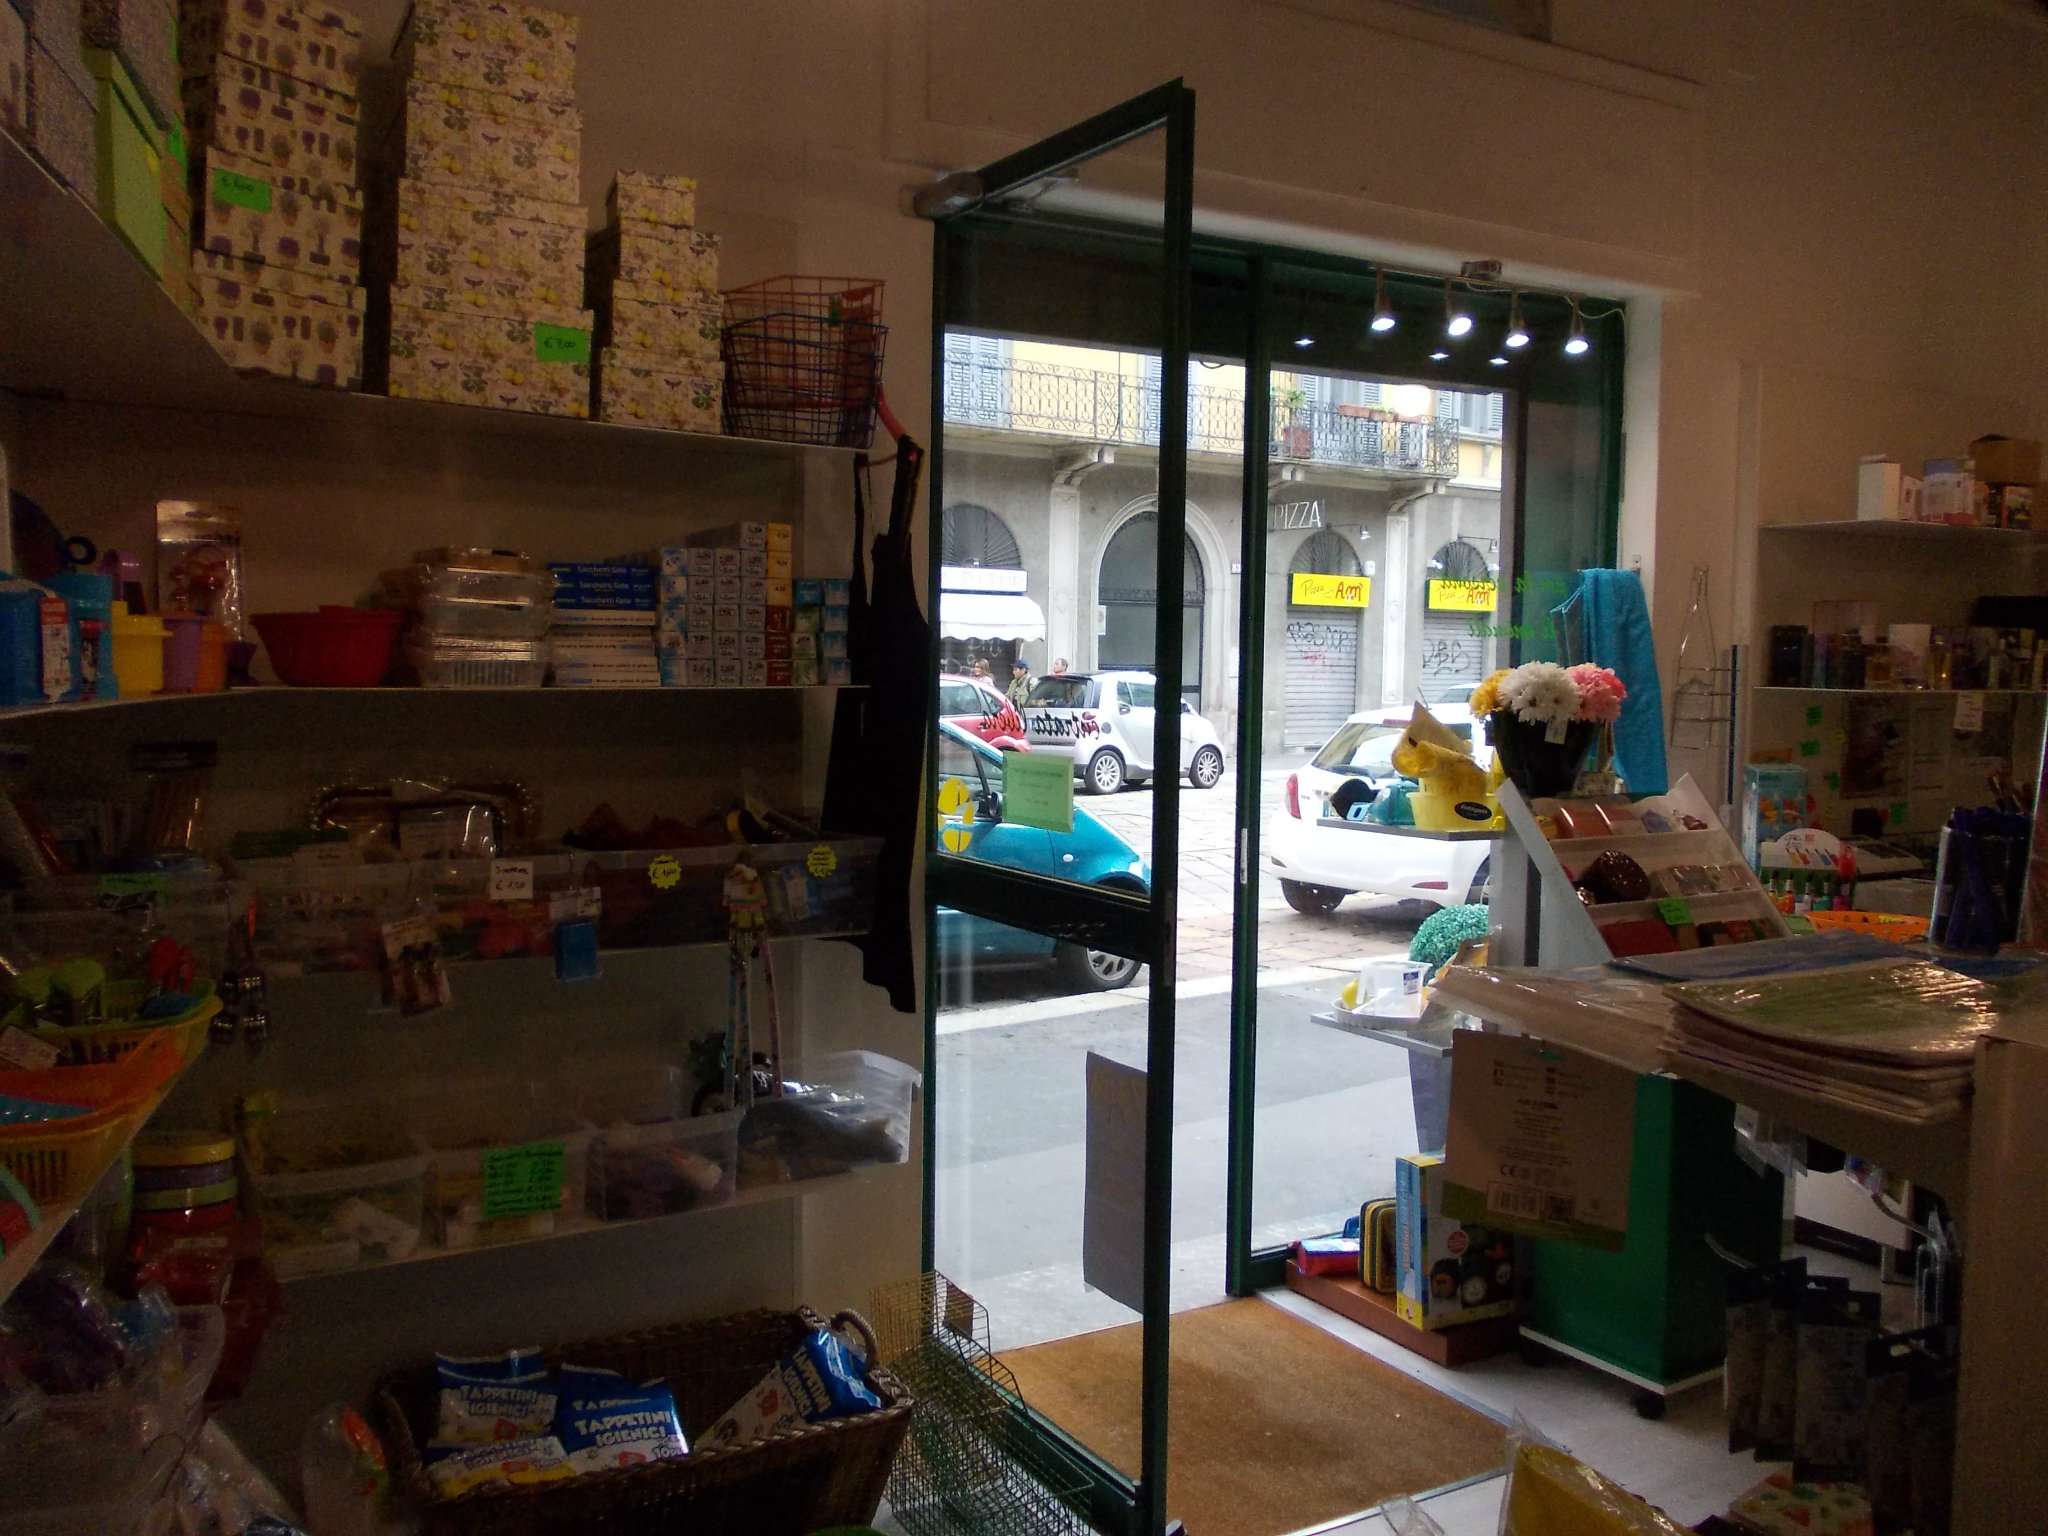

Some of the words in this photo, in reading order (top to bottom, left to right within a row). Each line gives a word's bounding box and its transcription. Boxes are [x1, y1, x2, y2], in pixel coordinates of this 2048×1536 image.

[1274, 500, 1321, 529] PIZZA
[574, 1411, 671, 1436] TAPPETINI
[596, 1426, 667, 1447] IGIENICI
